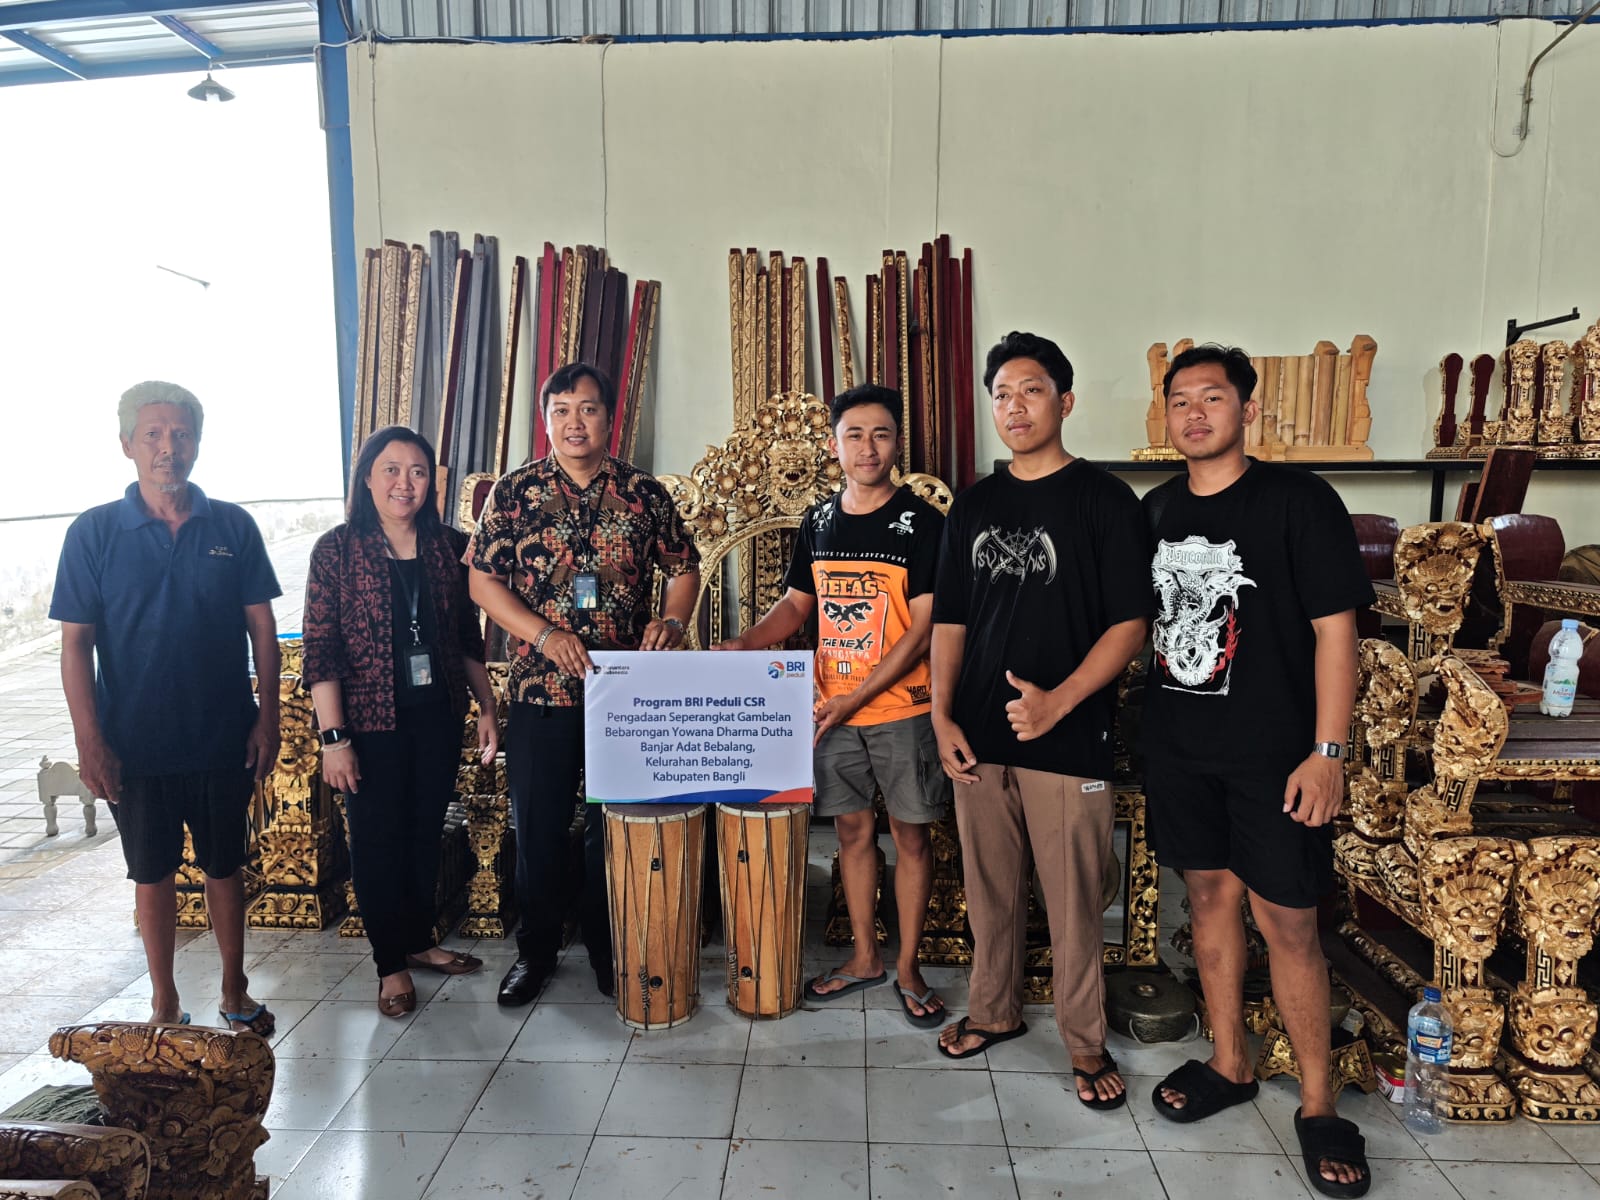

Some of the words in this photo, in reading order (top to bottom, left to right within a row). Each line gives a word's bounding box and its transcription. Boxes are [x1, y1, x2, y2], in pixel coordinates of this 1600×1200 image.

[859, 552, 907, 563] ADVENTURE
[820, 579, 877, 597] JELAS
[822, 638, 837, 647] THE
[839, 632, 873, 650] NEXT
[786, 661, 805, 672] BRI
[633, 697, 682, 709] Program
[684, 697, 703, 707] BRI
[706, 696, 741, 707] Peduli
[743, 697, 766, 707] CSR
[607, 712, 666, 724] Pengadaan
[669, 711, 735, 724] Seperangkat
[737, 711, 791, 722] Gambelan
[605, 727, 669, 739] Bebarongan
[672, 727, 714, 737] Yowana
[716, 726, 758, 737] Dharma
[761, 726, 793, 737] Dutha
[640, 741, 674, 754] Banjar
[676, 741, 701, 752] Adat
[703, 741, 756, 754] Bebalang,
[645, 756, 698, 767] Kelurahan
[701, 756, 753, 769] Bebalang,
[653, 771, 710, 783] Kabupaten
[712, 771, 746, 784] Bangli
